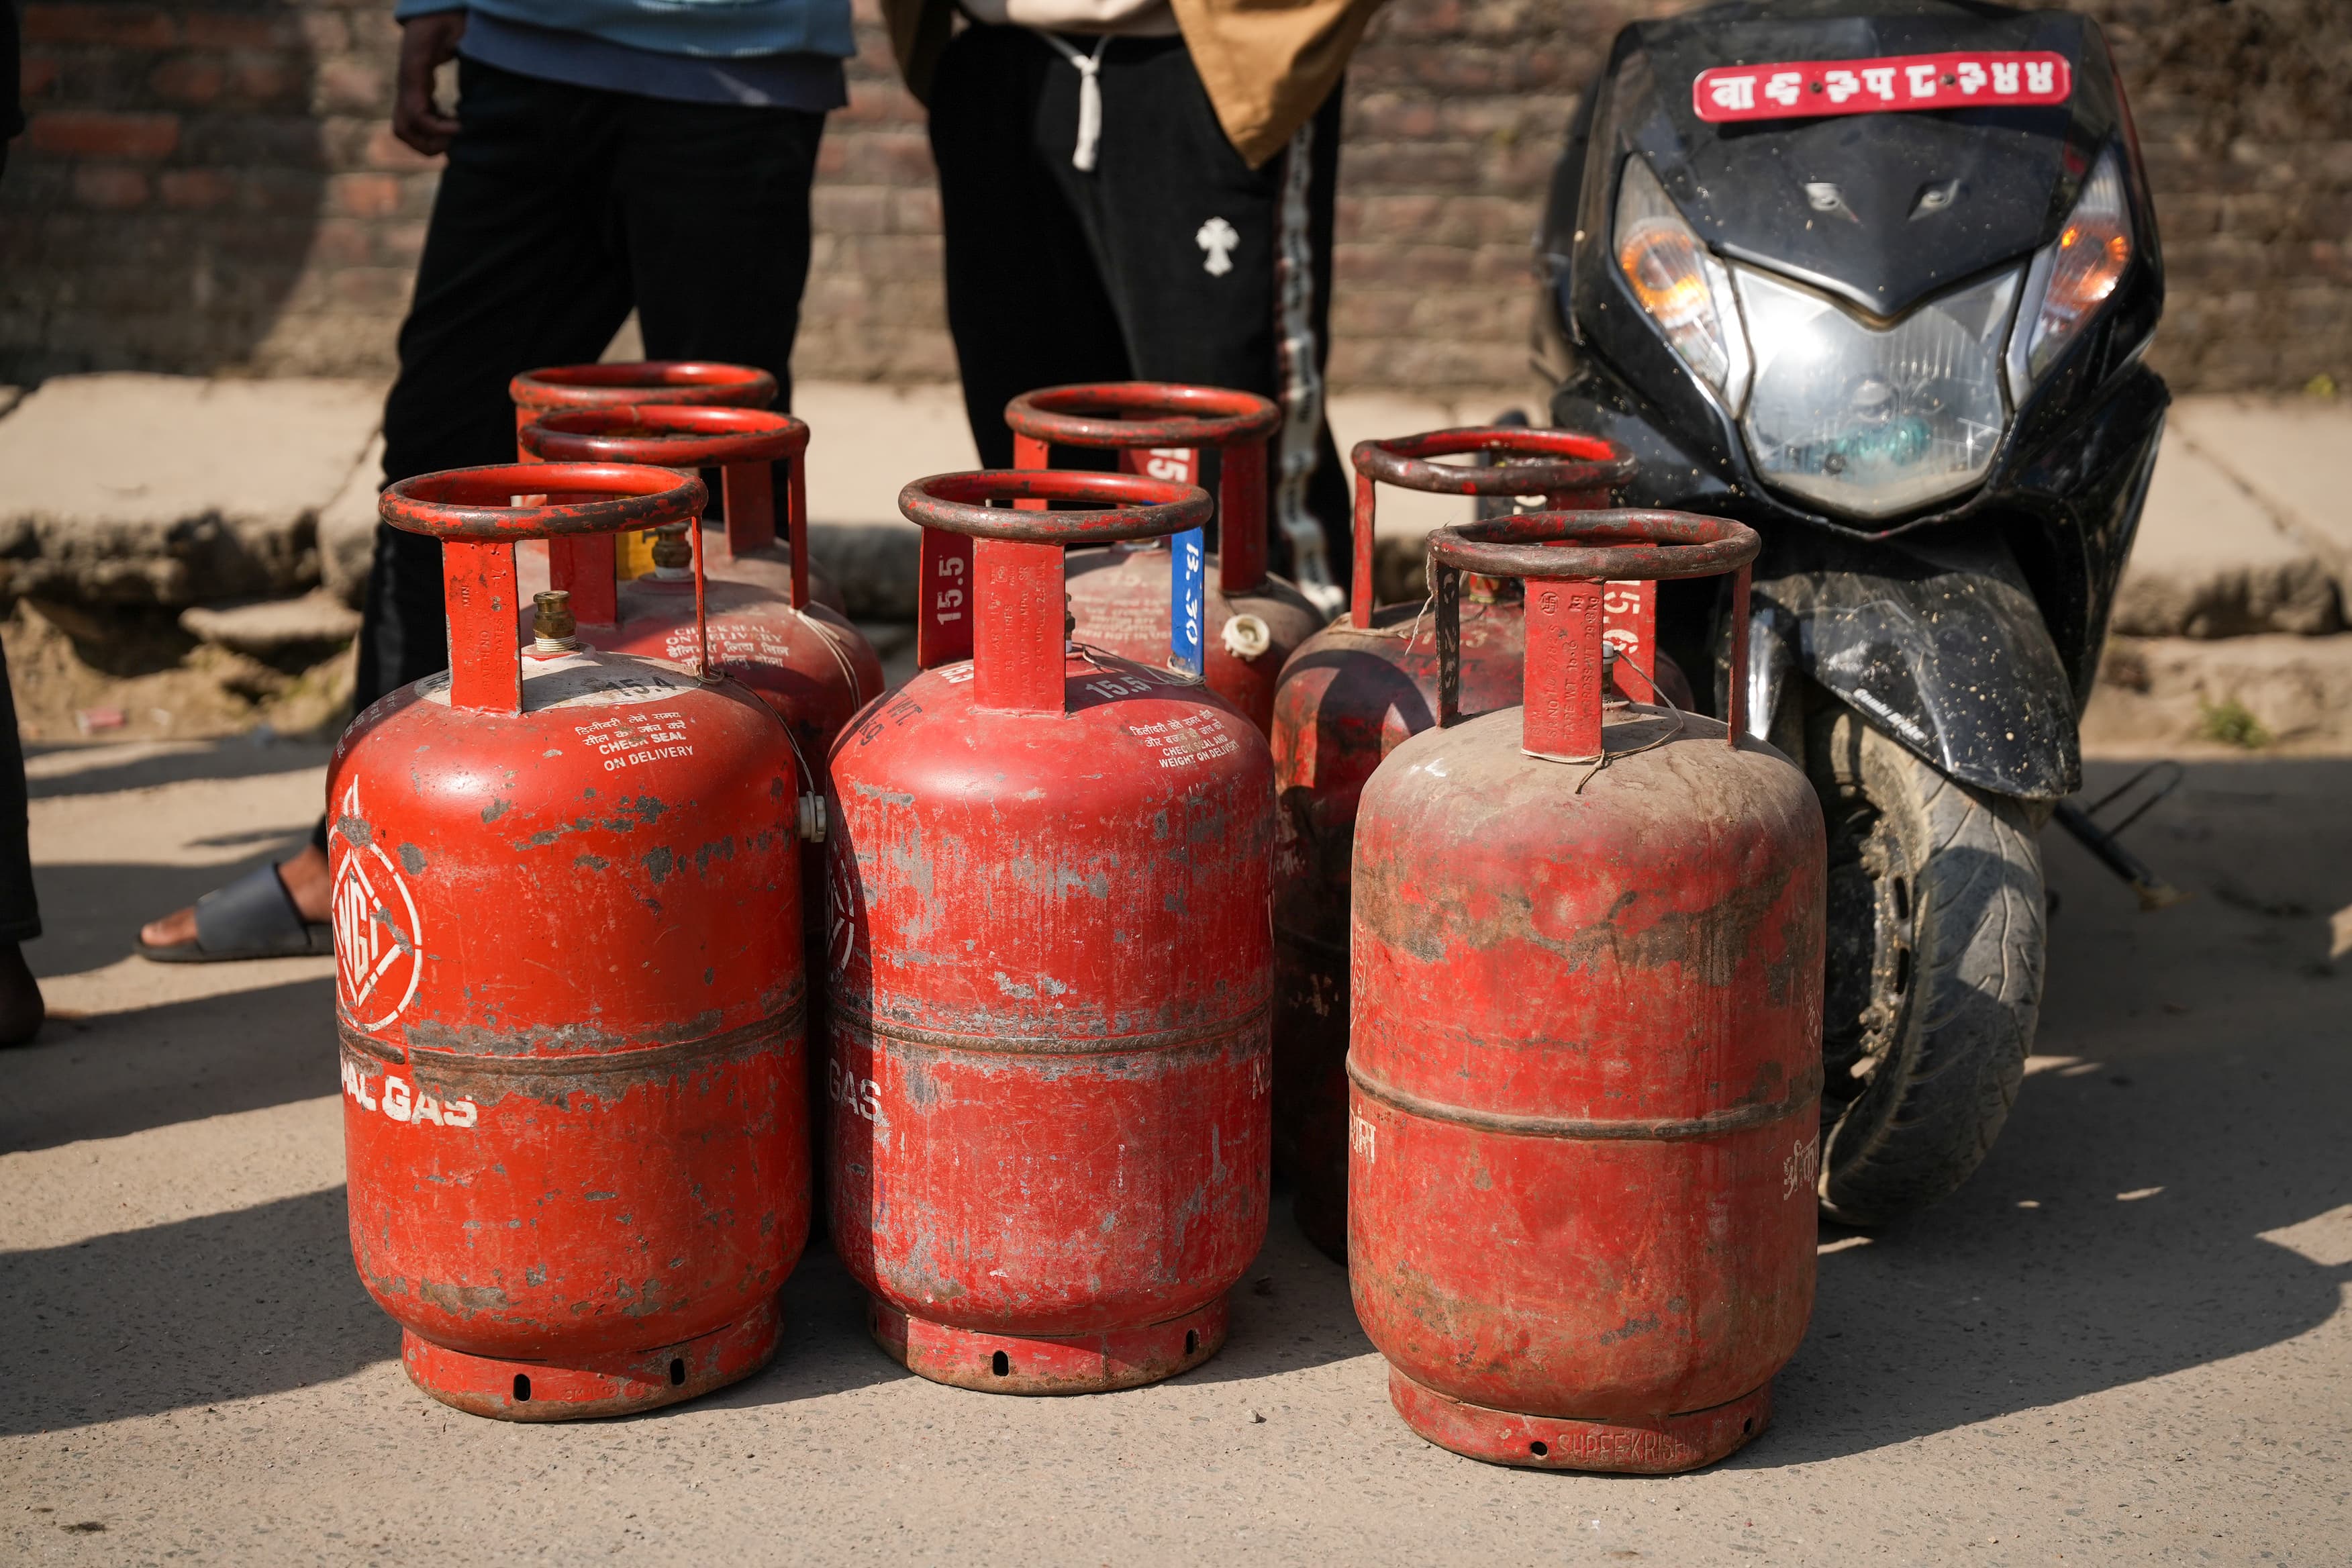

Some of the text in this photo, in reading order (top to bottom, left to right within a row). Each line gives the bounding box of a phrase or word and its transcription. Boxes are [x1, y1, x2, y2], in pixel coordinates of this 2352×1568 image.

[937, 557, 964, 626] 15.5
[666, 632, 783, 645] ON ELIVERY
[675, 625, 729, 636] CHCK
[605, 676, 677, 697] 15.4
[1085, 676, 1153, 699] 15.5
[575, 718, 622, 736] डिलीवरी
[1130, 722, 1168, 736] डिलीवरी
[599, 731, 687, 755] CHECK SEAL
[1144, 736, 1163, 748] और
[1162, 734, 1228, 756] CHECK SEAL AND
[604, 745, 693, 771] ON DELIVERY
[1159, 739, 1240, 768] WEIGHT ON DELIVERY
[829, 1057, 882, 1123] GAS
[381, 1075, 478, 1128] GAS
